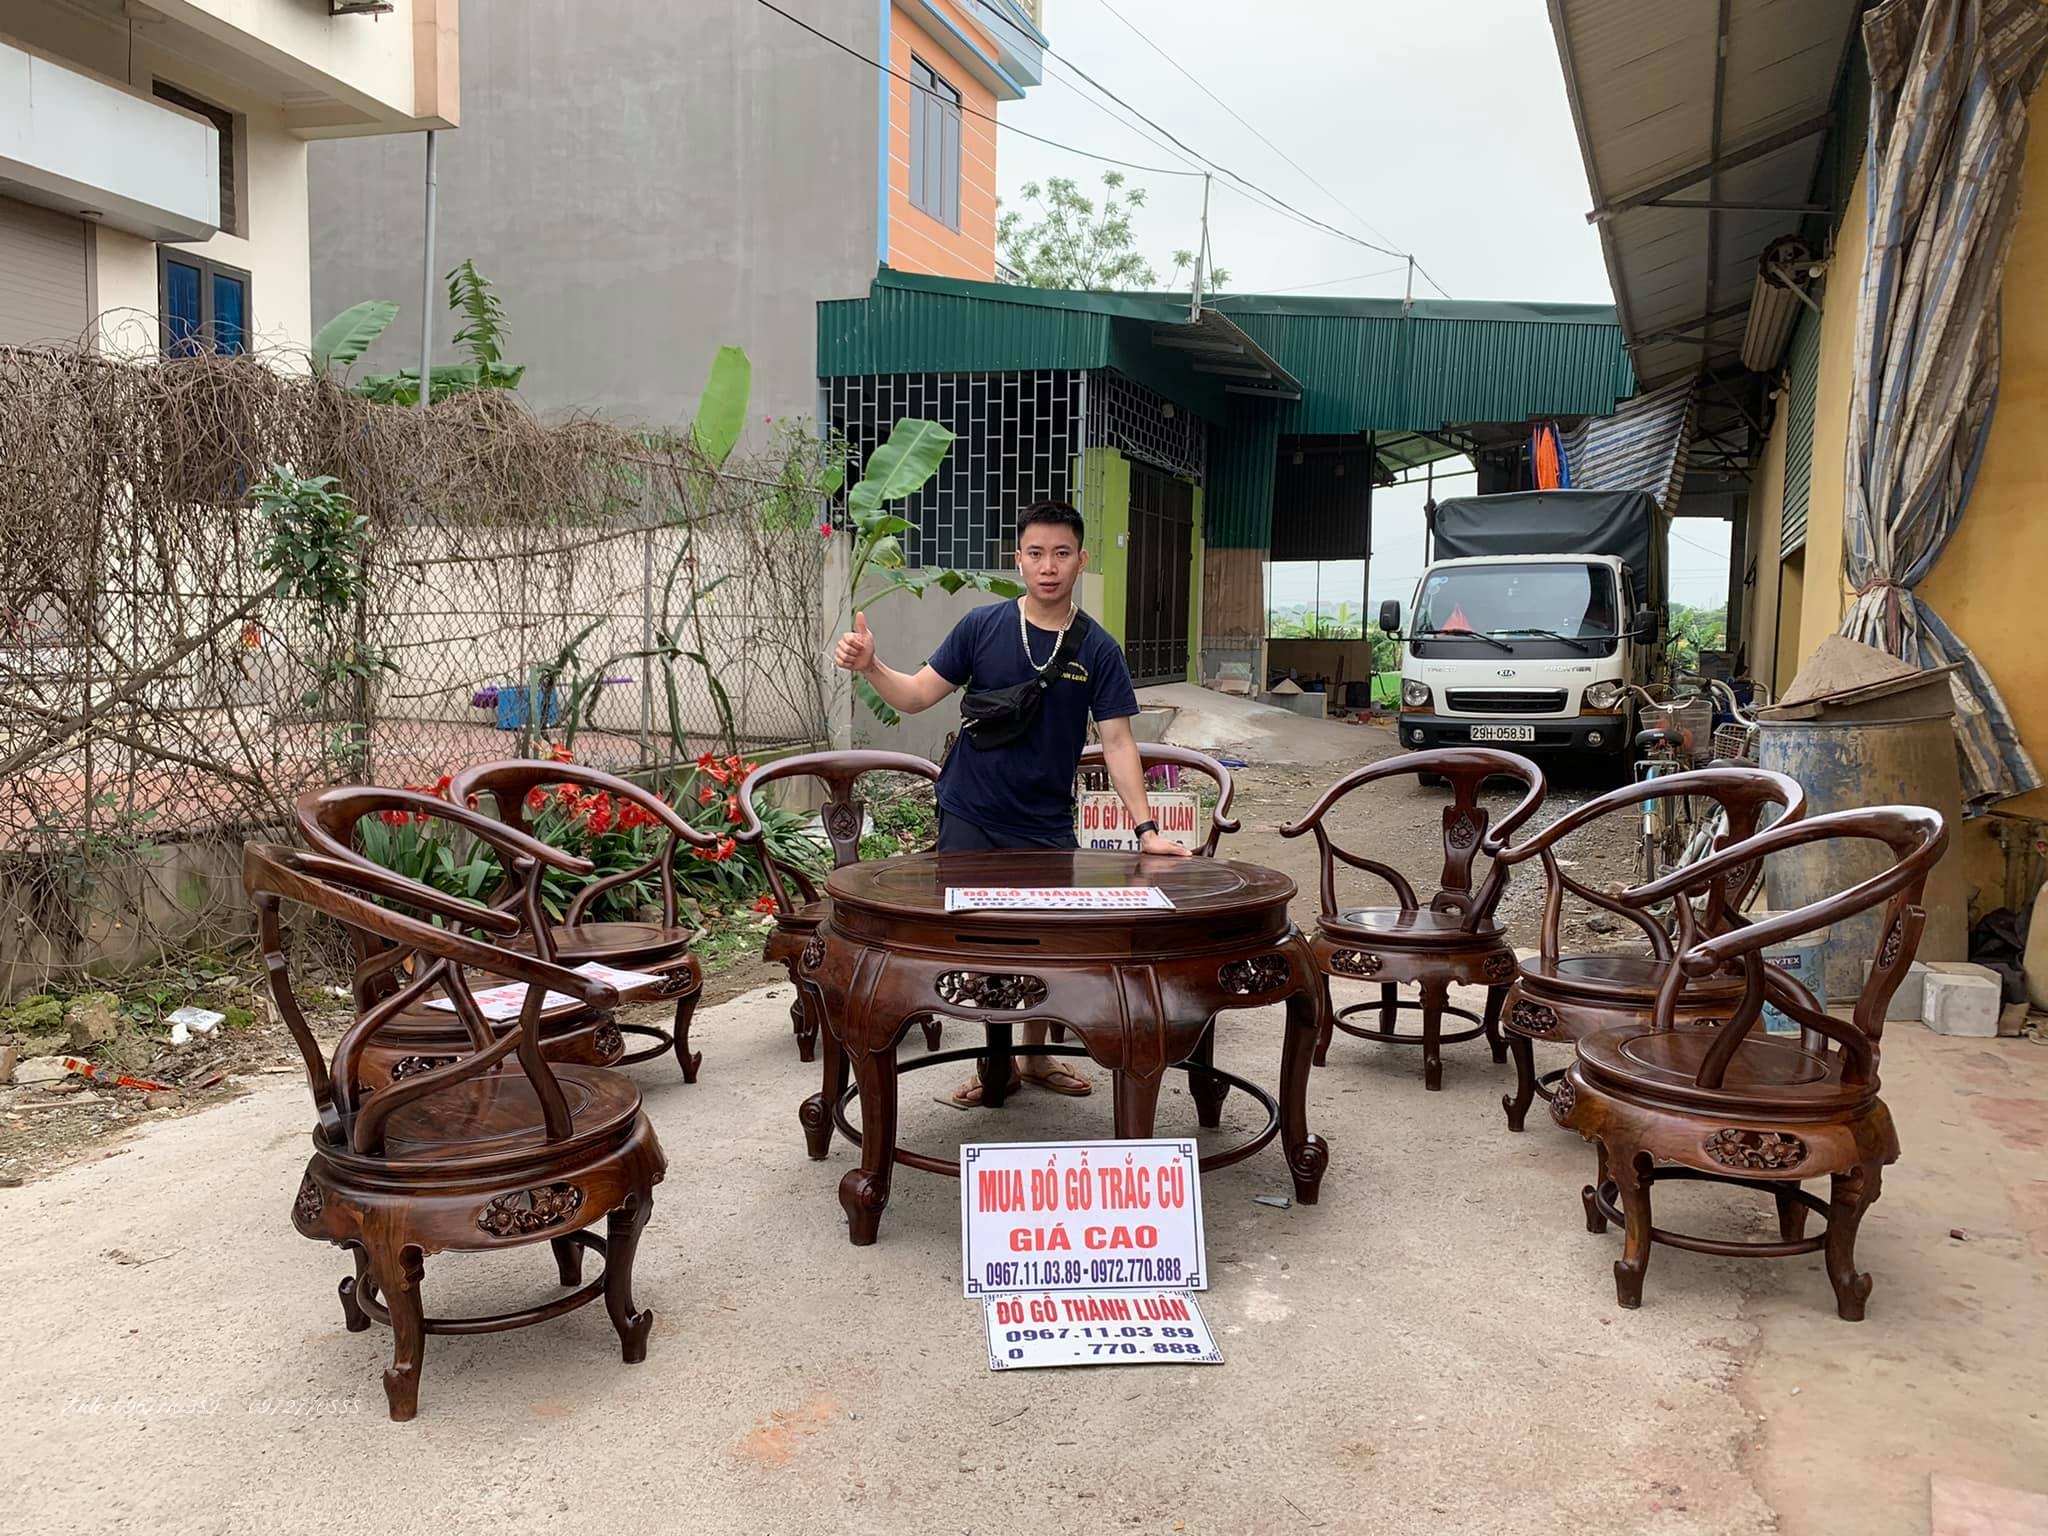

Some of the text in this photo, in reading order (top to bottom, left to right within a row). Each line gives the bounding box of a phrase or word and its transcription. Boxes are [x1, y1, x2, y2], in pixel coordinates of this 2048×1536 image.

[1472, 727, 1533, 740] 29H-058.91
[1163, 801, 1193, 831] LUÂN
[978, 1151, 1185, 1212] MUA ĐỒ GỖ TRẮC CŨ
[1009, 1222, 1159, 1252] GIÁ CAO
[996, 1294, 1025, 1325] ĐỒ
[1061, 1295, 1132, 1322] THÀNH
[1133, 1294, 1191, 1321] LUÂN
